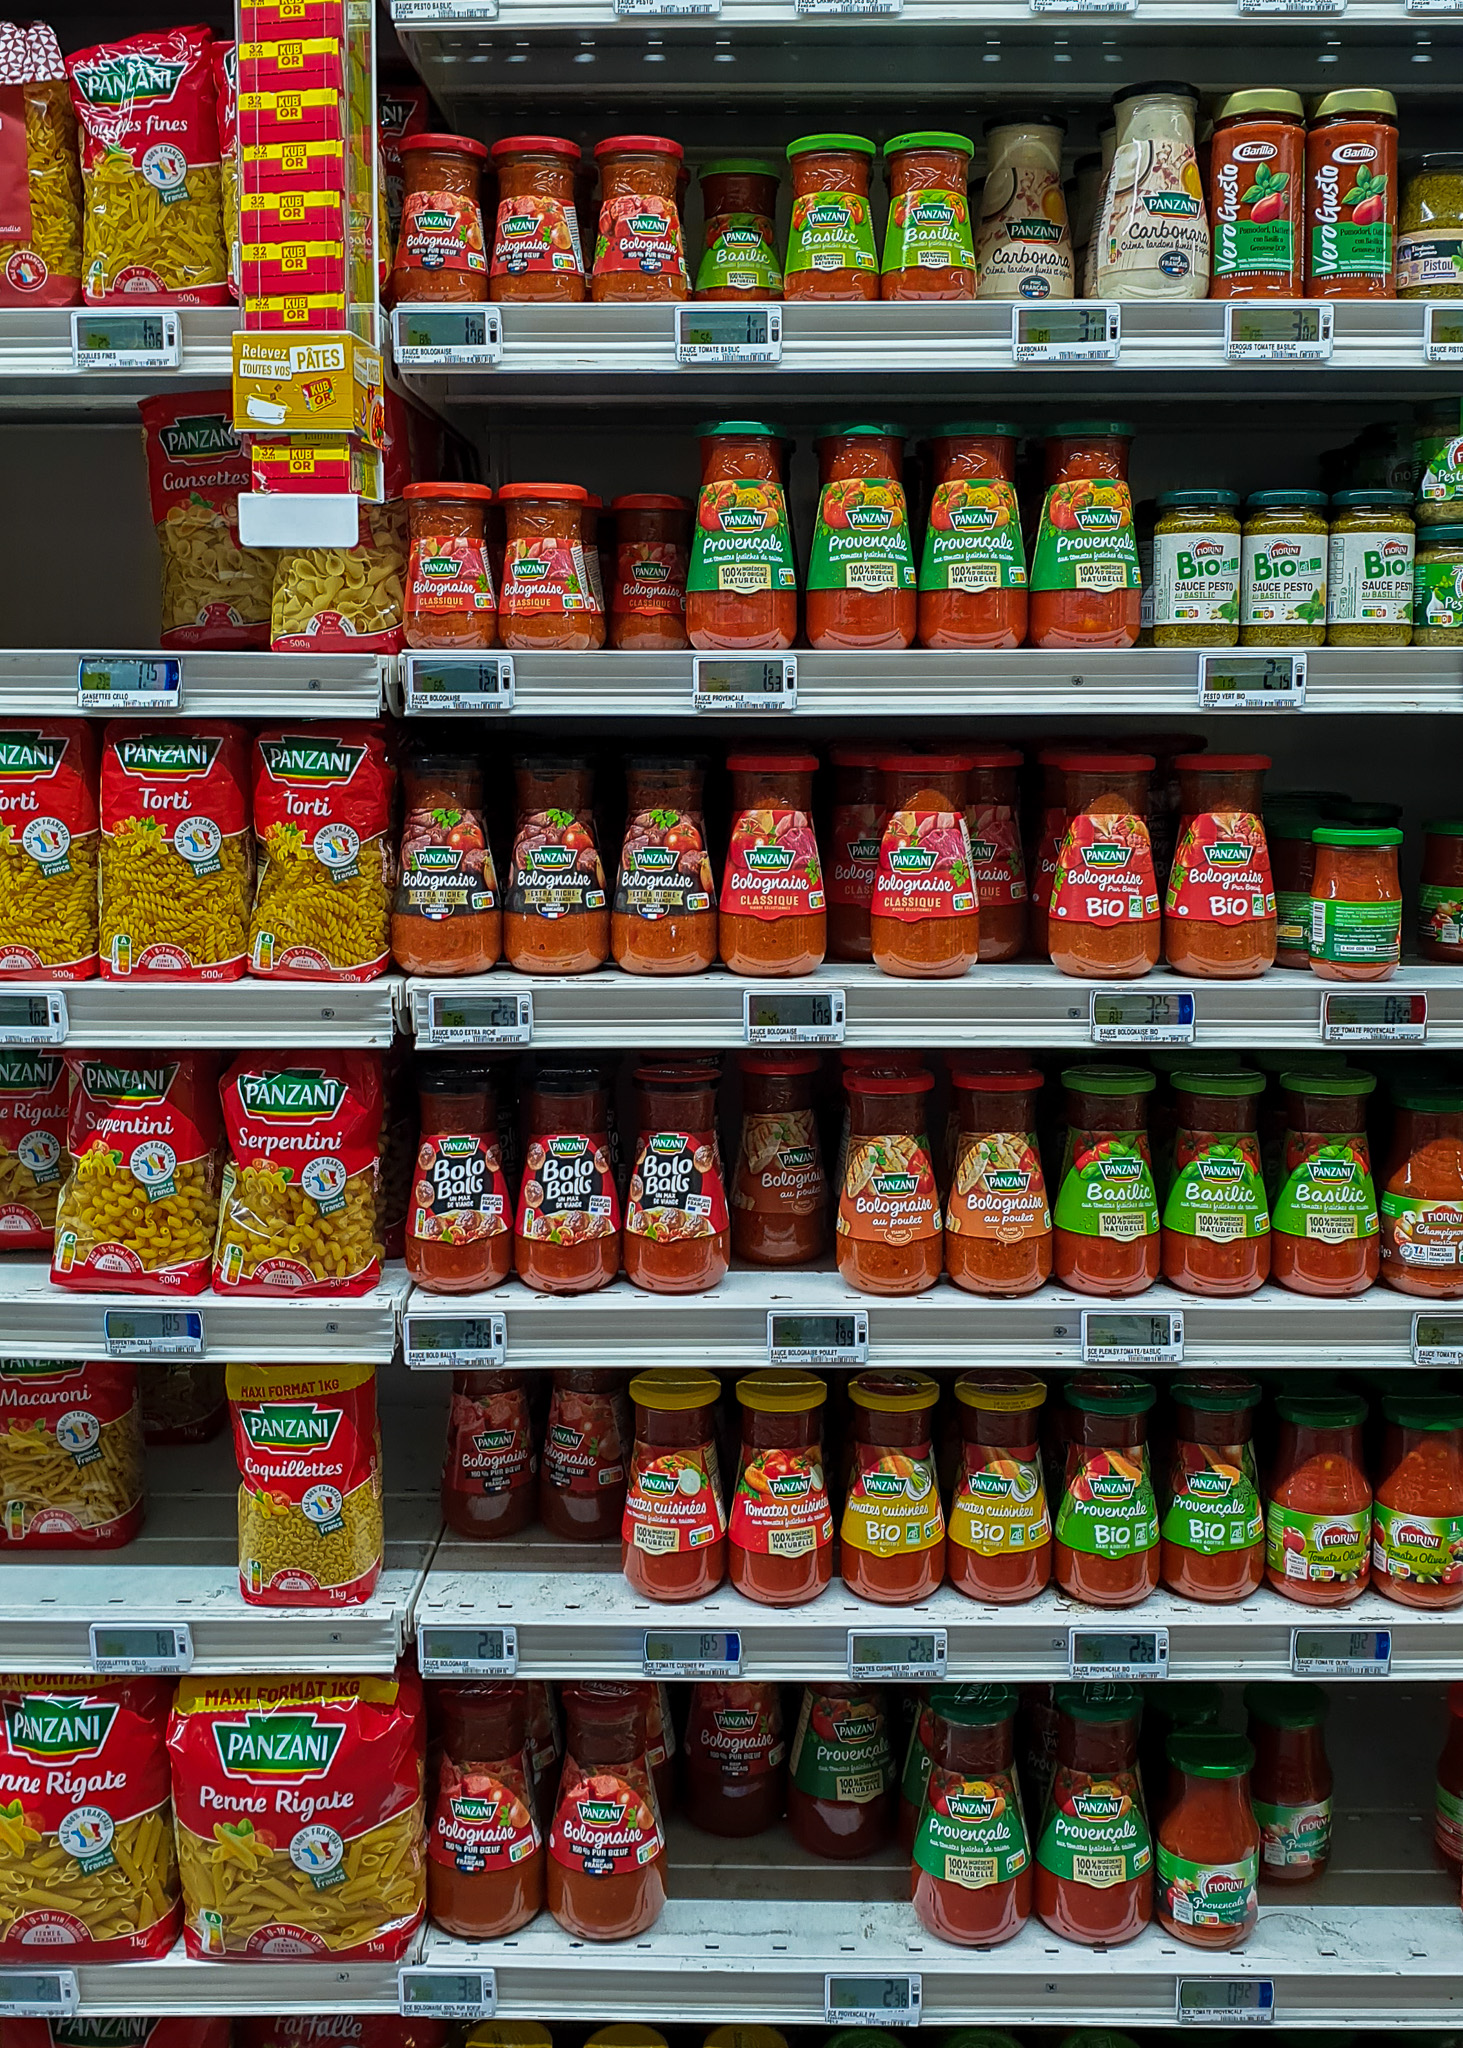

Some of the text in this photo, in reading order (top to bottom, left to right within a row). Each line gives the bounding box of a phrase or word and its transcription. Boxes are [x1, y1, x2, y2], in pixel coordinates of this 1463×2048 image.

[249, 44, 263, 56] 32
[278, 43, 302, 67] KUB OR
[247, 95, 261, 107] 32
[277, 94, 300, 118] KUB OR
[145, 116, 188, 134] fines
[253, 145, 267, 156] 32
[282, 145, 305, 169] KUB OR
[1242, 145, 1274, 156] Barilla
[1342, 146, 1375, 158] Barilla
[280, 195, 303, 219] KUB OR
[418, 217, 456, 230] PANZANI
[503, 220, 539, 234] PANZANI
[631, 219, 668, 232] PANZANI
[801, 229, 858, 245] Basilic
[905, 227, 962, 243] Basilic
[1129, 221, 1209, 246] Carbonara
[281, 246, 305, 269] KUB OR
[992, 248, 1070, 269] Carbonara
[1423, 259, 1454, 272] Pistou
[177, 294, 200, 304] 500g
[284, 297, 307, 320] KUB OR
[242, 344, 287, 361] Relevez
[296, 346, 341, 371] PÂTES
[242, 365, 291, 377] TOUTES VOS
[290, 449, 313, 472] KUB OR
[163, 471, 249, 491] Gansettes
[724, 513, 763, 526] PANZANI
[852, 512, 889, 524] PANZANI
[955, 513, 993, 525] PANZANI
[1082, 512, 1118, 524] PANZANI
[933, 533, 1014, 552] Provençale
[723, 576, 768, 584] NATURELLE
[851, 573, 895, 582] NATURELLE
[952, 574, 997, 583] NATURELLE
[1175, 581, 1234, 592] SAUCE PESTO
[1252, 582, 1313, 592] SAUCE PESTO
[1362, 581, 1393, 590] SAUCE
[1184, 591, 1216, 599] BASILIC
[1260, 592, 1291, 600] BASILIC
[1371, 590, 1402, 598] BASILIC
[419, 596, 464, 606] CLASSIQUE
[509, 598, 551, 606] CLASSIQUE
[289, 639, 311, 649] 500g
[139, 788, 192, 810] Torti
[287, 793, 332, 817] Torti
[419, 852, 457, 864] PANZANI
[534, 852, 571, 864] PANZANI
[637, 853, 673, 865] PANZANI
[750, 852, 789, 865] PANZANI
[893, 854, 932, 867] PANZANI
[1086, 849, 1125, 862] PANZANI
[1209, 849, 1248, 861] PANZANI
[402, 872, 477, 889] Bolognaise
[518, 871, 591, 889] Bolognaise
[622, 871, 693, 889] Bolognaise
[884, 897, 941, 908] CLASSIQUE
[246, 1082, 336, 1106] PANZANI
[13, 1102, 69, 1125] Rigate
[86, 1111, 174, 1138] Serpentini
[238, 1127, 342, 1156] Serpentini
[434, 1159, 486, 1182] Bolo
[543, 1159, 594, 1181] Bolo
[644, 1156, 693, 1177] Bolo
[1105, 1162, 1139, 1174] PANZANI
[1204, 1165, 1240, 1177] PANZANI
[1314, 1165, 1350, 1177] PANZANI
[438, 1177, 483, 1199] Balls
[547, 1177, 592, 1198] Balls
[645, 1174, 689, 1194] Balls
[989, 1178, 1027, 1190] PANZANI
[1185, 1183, 1256, 1203] Basilic
[872, 1215, 923, 1228] au poulet
[1002, 1213, 1034, 1226] poulet
[159, 1276, 181, 1285] 500g
[241, 1379, 339, 1398] MAXI FORMAT 1KG
[251, 1417, 328, 1438] PANZANI
[244, 1457, 343, 1478] Coquillettes
[654, 1500, 707, 1516] cuisinées
[882, 1502, 929, 1517] cuisinées
[986, 1504, 1034, 1518] cuisinées
[1074, 1500, 1148, 1521] Provençale
[1173, 1496, 1246, 1515] Provençale
[1324, 1533, 1358, 1545] FIORINI
[1401, 1532, 1439, 1547] FIORINI
[1308, 1551, 1341, 1562] Tomates
[1419, 1552, 1447, 1565] Olives
[329, 1588, 346, 1601] 1kg
[205, 1679, 360, 1706] MAXI FORMAT 1KG
[228, 1733, 328, 1761] PANZANI
[47, 1770, 126, 1804] Rigate
[200, 1786, 353, 1822] Penne Rigate
[454, 1804, 491, 1817] PANZANI
[951, 1801, 992, 1815] PANZANI
[1078, 1801, 1118, 1814] PANZANI
[582, 1807, 620, 1819] PANZANI
[1209, 1882, 1245, 1894] FIORINI
[130, 1936, 147, 1948] 1kg
[367, 1941, 384, 1952] 1kg
